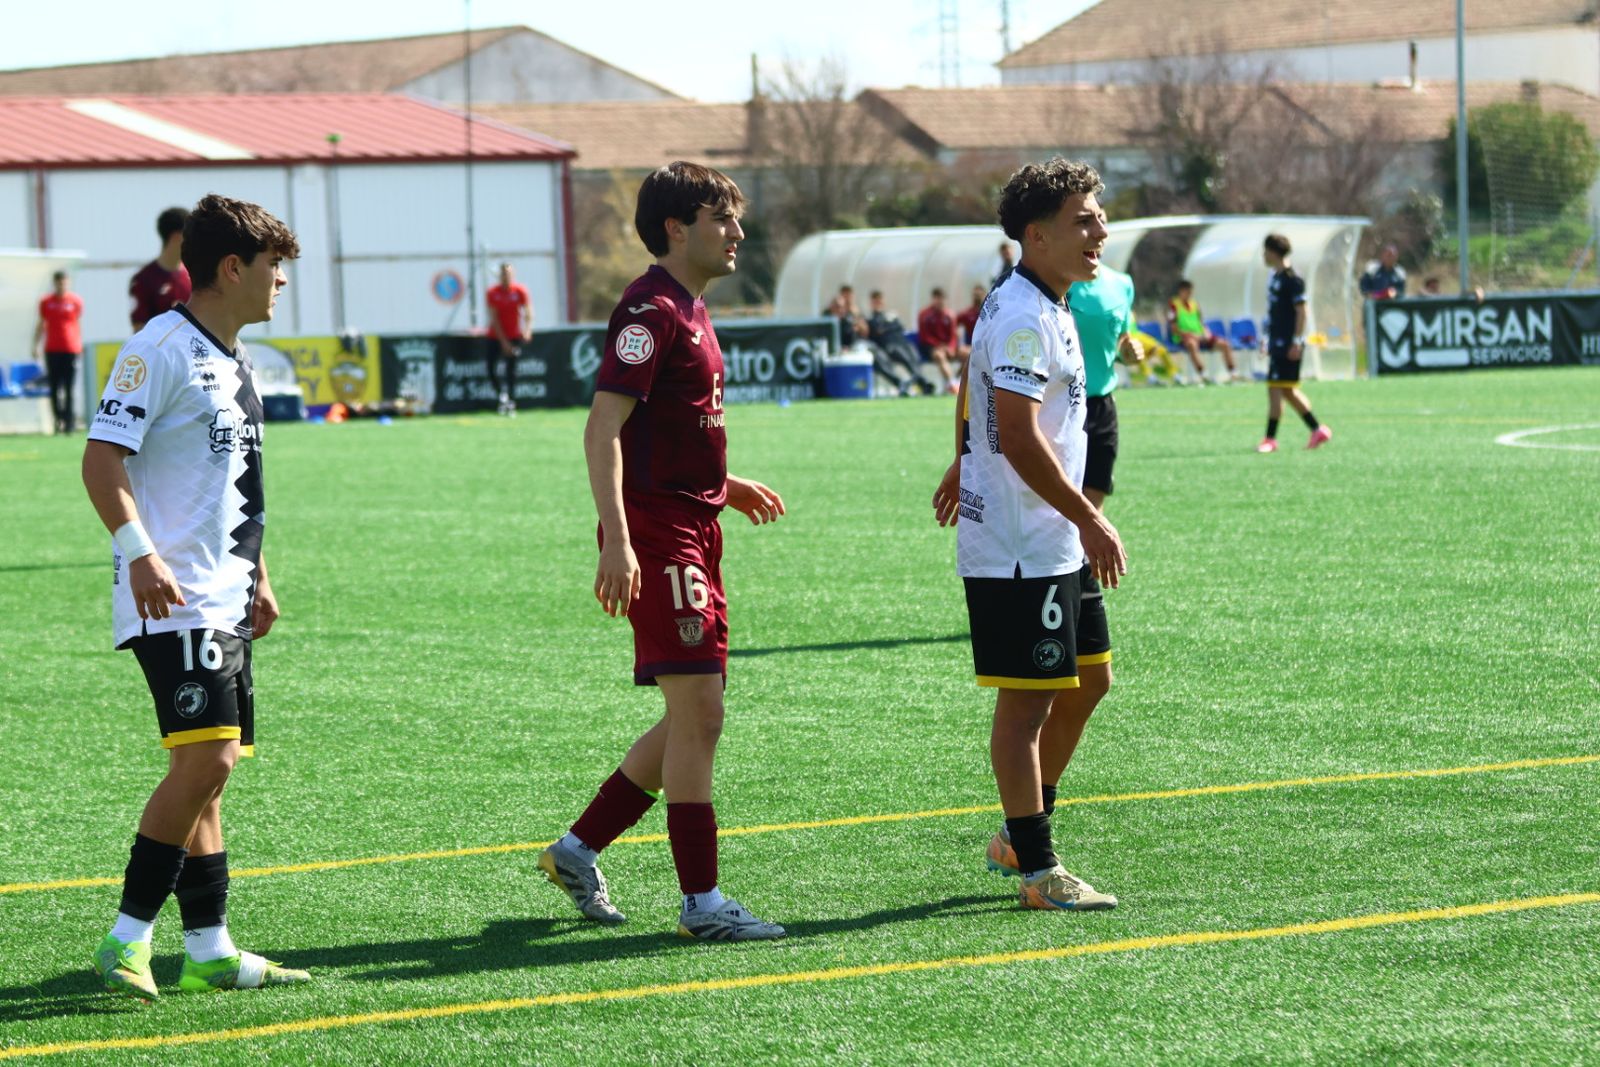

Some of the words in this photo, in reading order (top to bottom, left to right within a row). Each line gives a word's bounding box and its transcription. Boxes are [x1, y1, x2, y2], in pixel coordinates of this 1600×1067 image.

[1412, 305, 1553, 347] MIRSAN
[1471, 345, 1552, 365] SERVICIOS
[664, 565, 709, 610] 16
[1041, 584, 1063, 630] 6
[177, 629, 224, 672] 16
